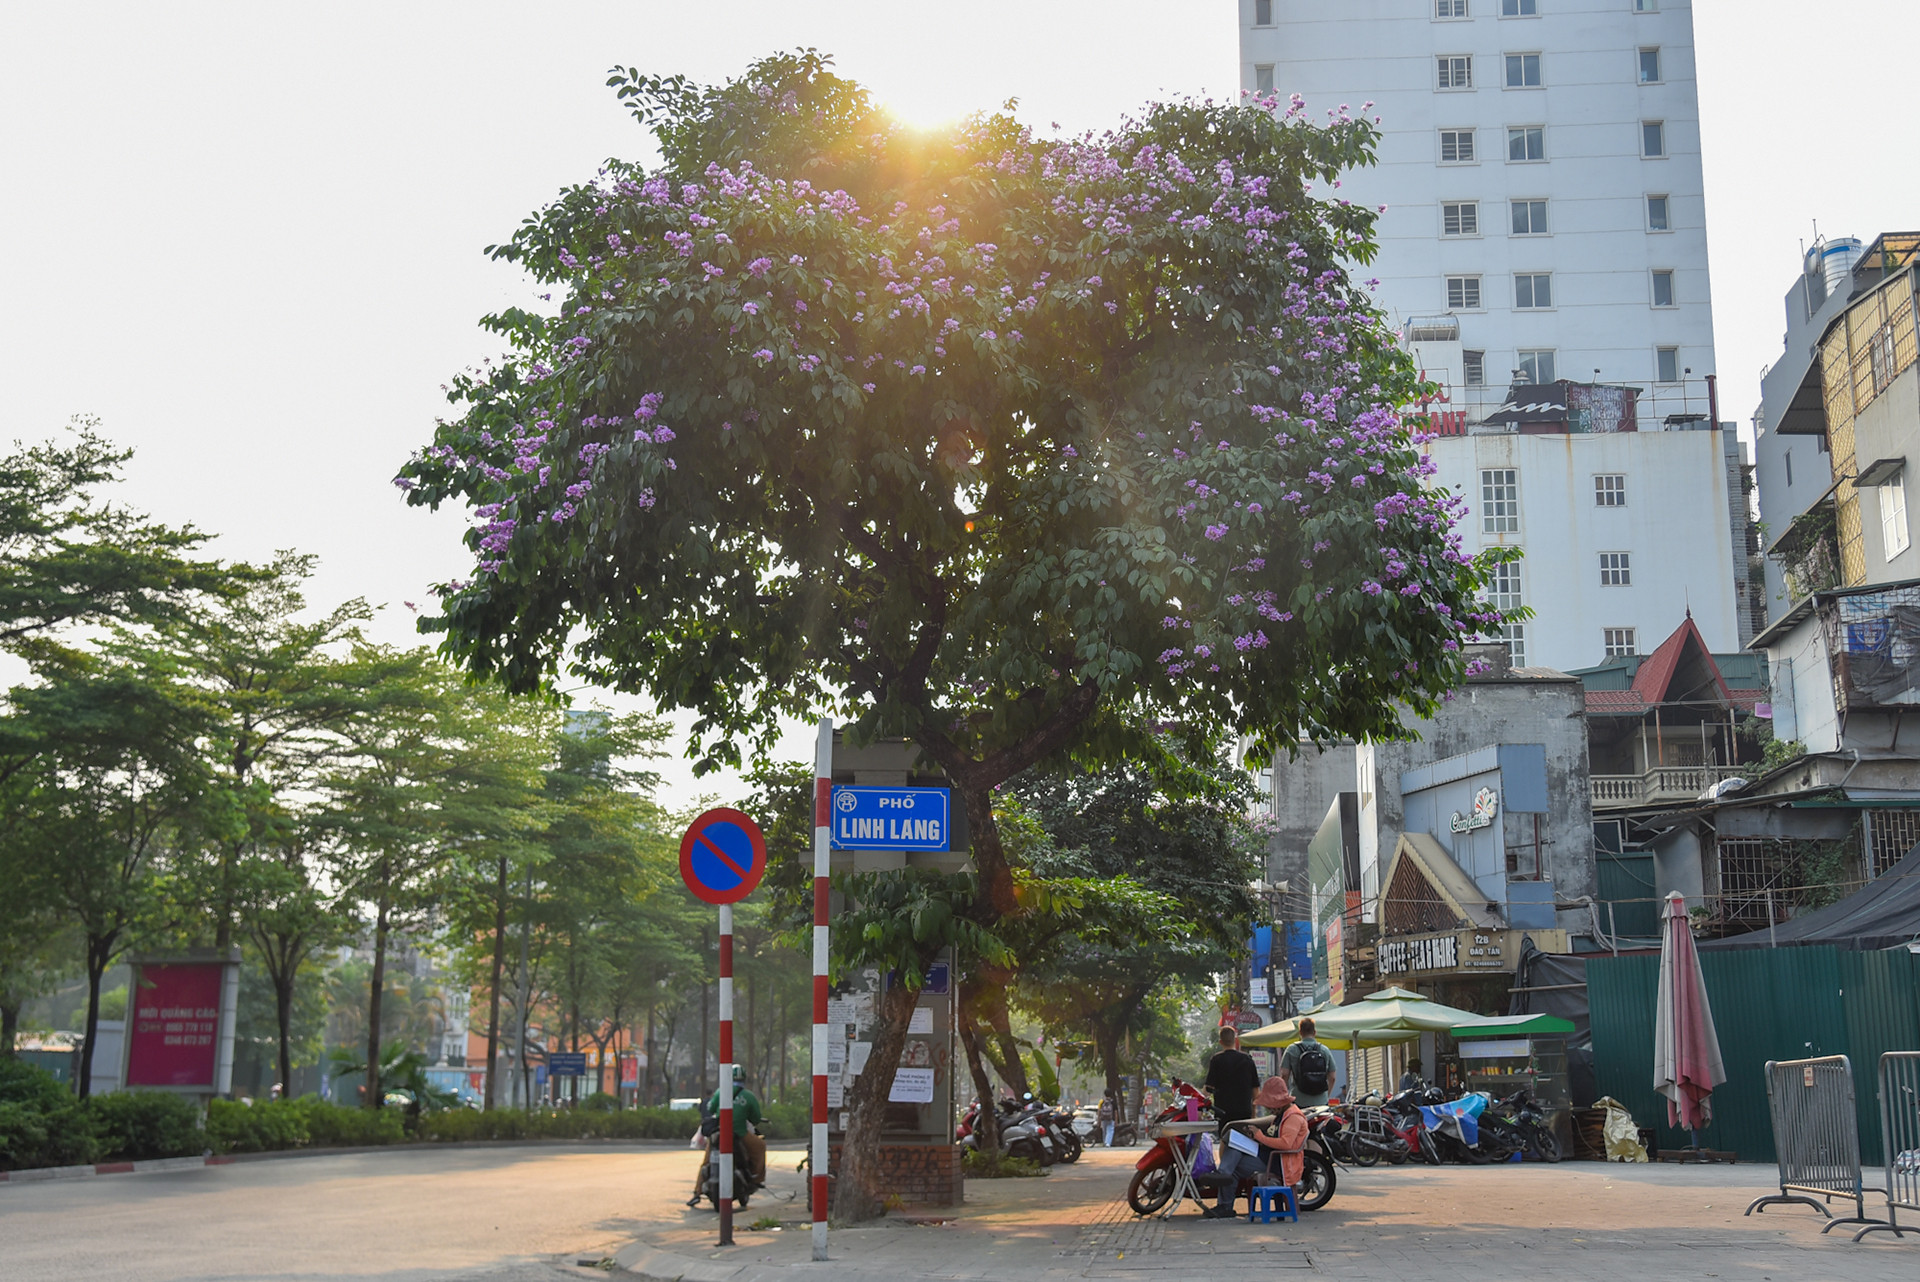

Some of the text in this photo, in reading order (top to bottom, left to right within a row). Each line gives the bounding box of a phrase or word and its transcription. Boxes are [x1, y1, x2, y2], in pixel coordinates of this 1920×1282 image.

[879, 793, 917, 809] PHỐ
[841, 817, 885, 839] LINH
[1450, 813, 1482, 832] Confetti
[1475, 935, 1489, 944] 12B
